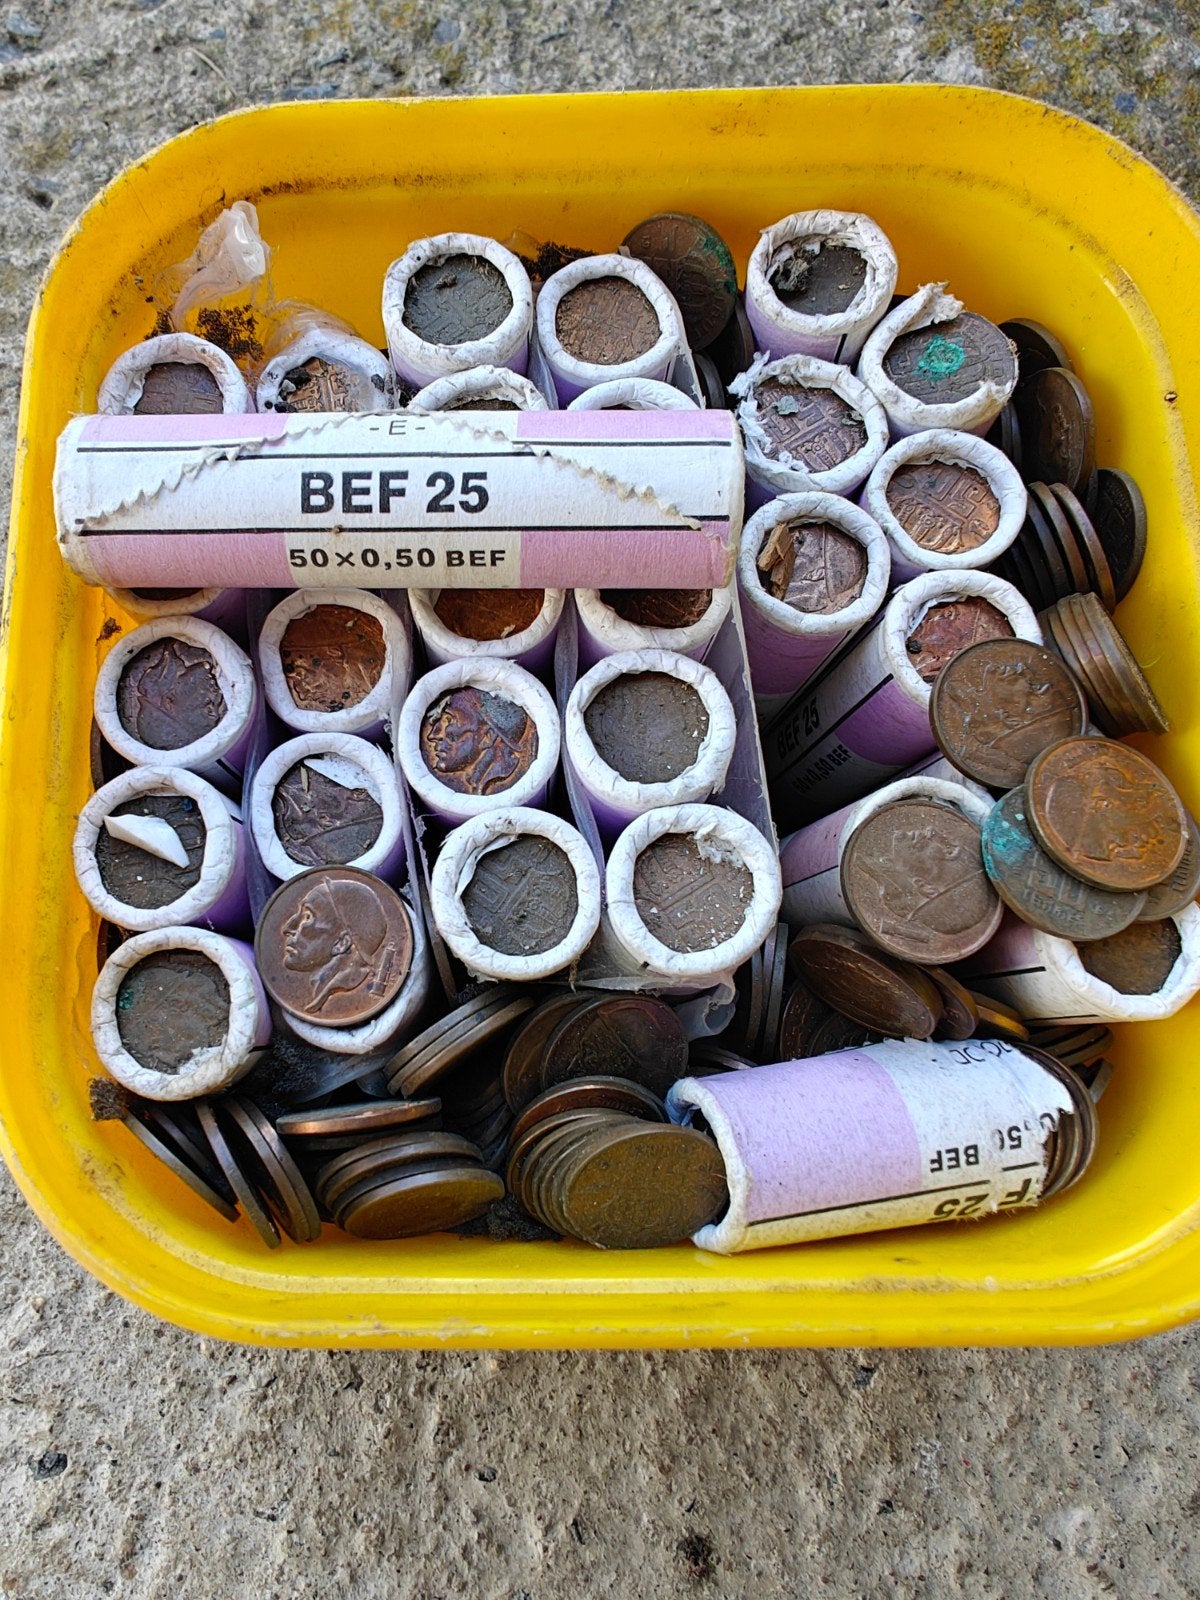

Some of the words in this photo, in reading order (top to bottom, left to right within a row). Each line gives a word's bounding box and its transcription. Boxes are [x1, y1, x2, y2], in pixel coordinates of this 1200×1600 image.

[300, 470, 409, 514] BEF
[425, 471, 490, 514] 25
[445, 549, 506, 568] BEF
[777, 716, 800, 759] BEF
[802, 697, 820, 737] 25
[827, 744, 852, 766] BEF
[929, 1144, 980, 1173] BEF
[926, 1193, 990, 1221] 25
